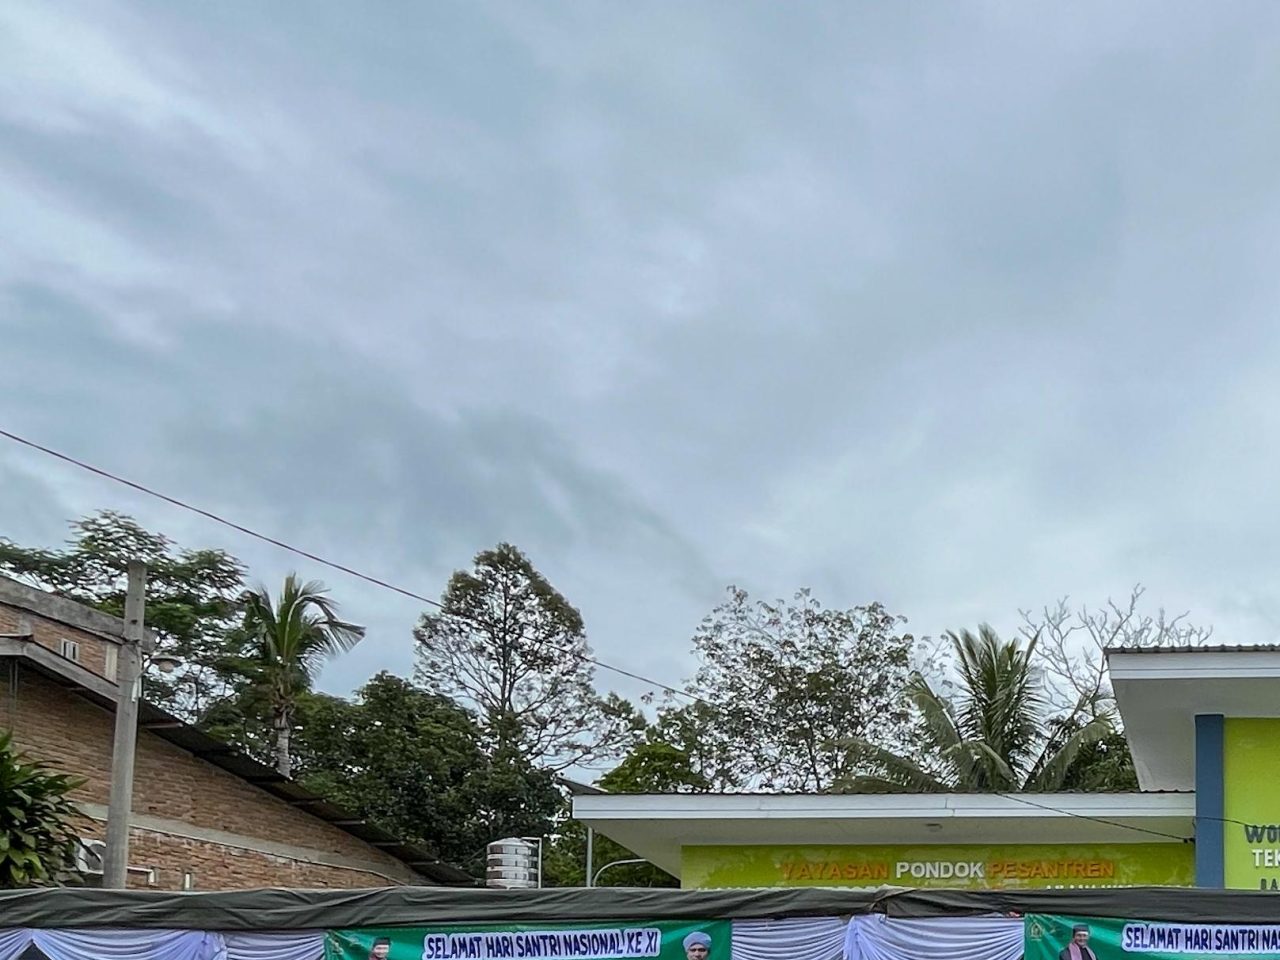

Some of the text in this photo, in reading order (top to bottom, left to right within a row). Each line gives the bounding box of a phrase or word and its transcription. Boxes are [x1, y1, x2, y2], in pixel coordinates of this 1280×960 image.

[781, 861, 1115, 880] YAYASAN PONDOK PESANTREN
[426, 934, 482, 959] SELAMAT
[485, 936, 515, 958] HARI
[517, 935, 561, 957] SANTRI
[626, 932, 643, 954] KE
[645, 930, 658, 953] XI
[1125, 926, 1181, 949] SELAMAT
[1184, 928, 1213, 949] HARI
[1215, 928, 1259, 950] SANTRI
